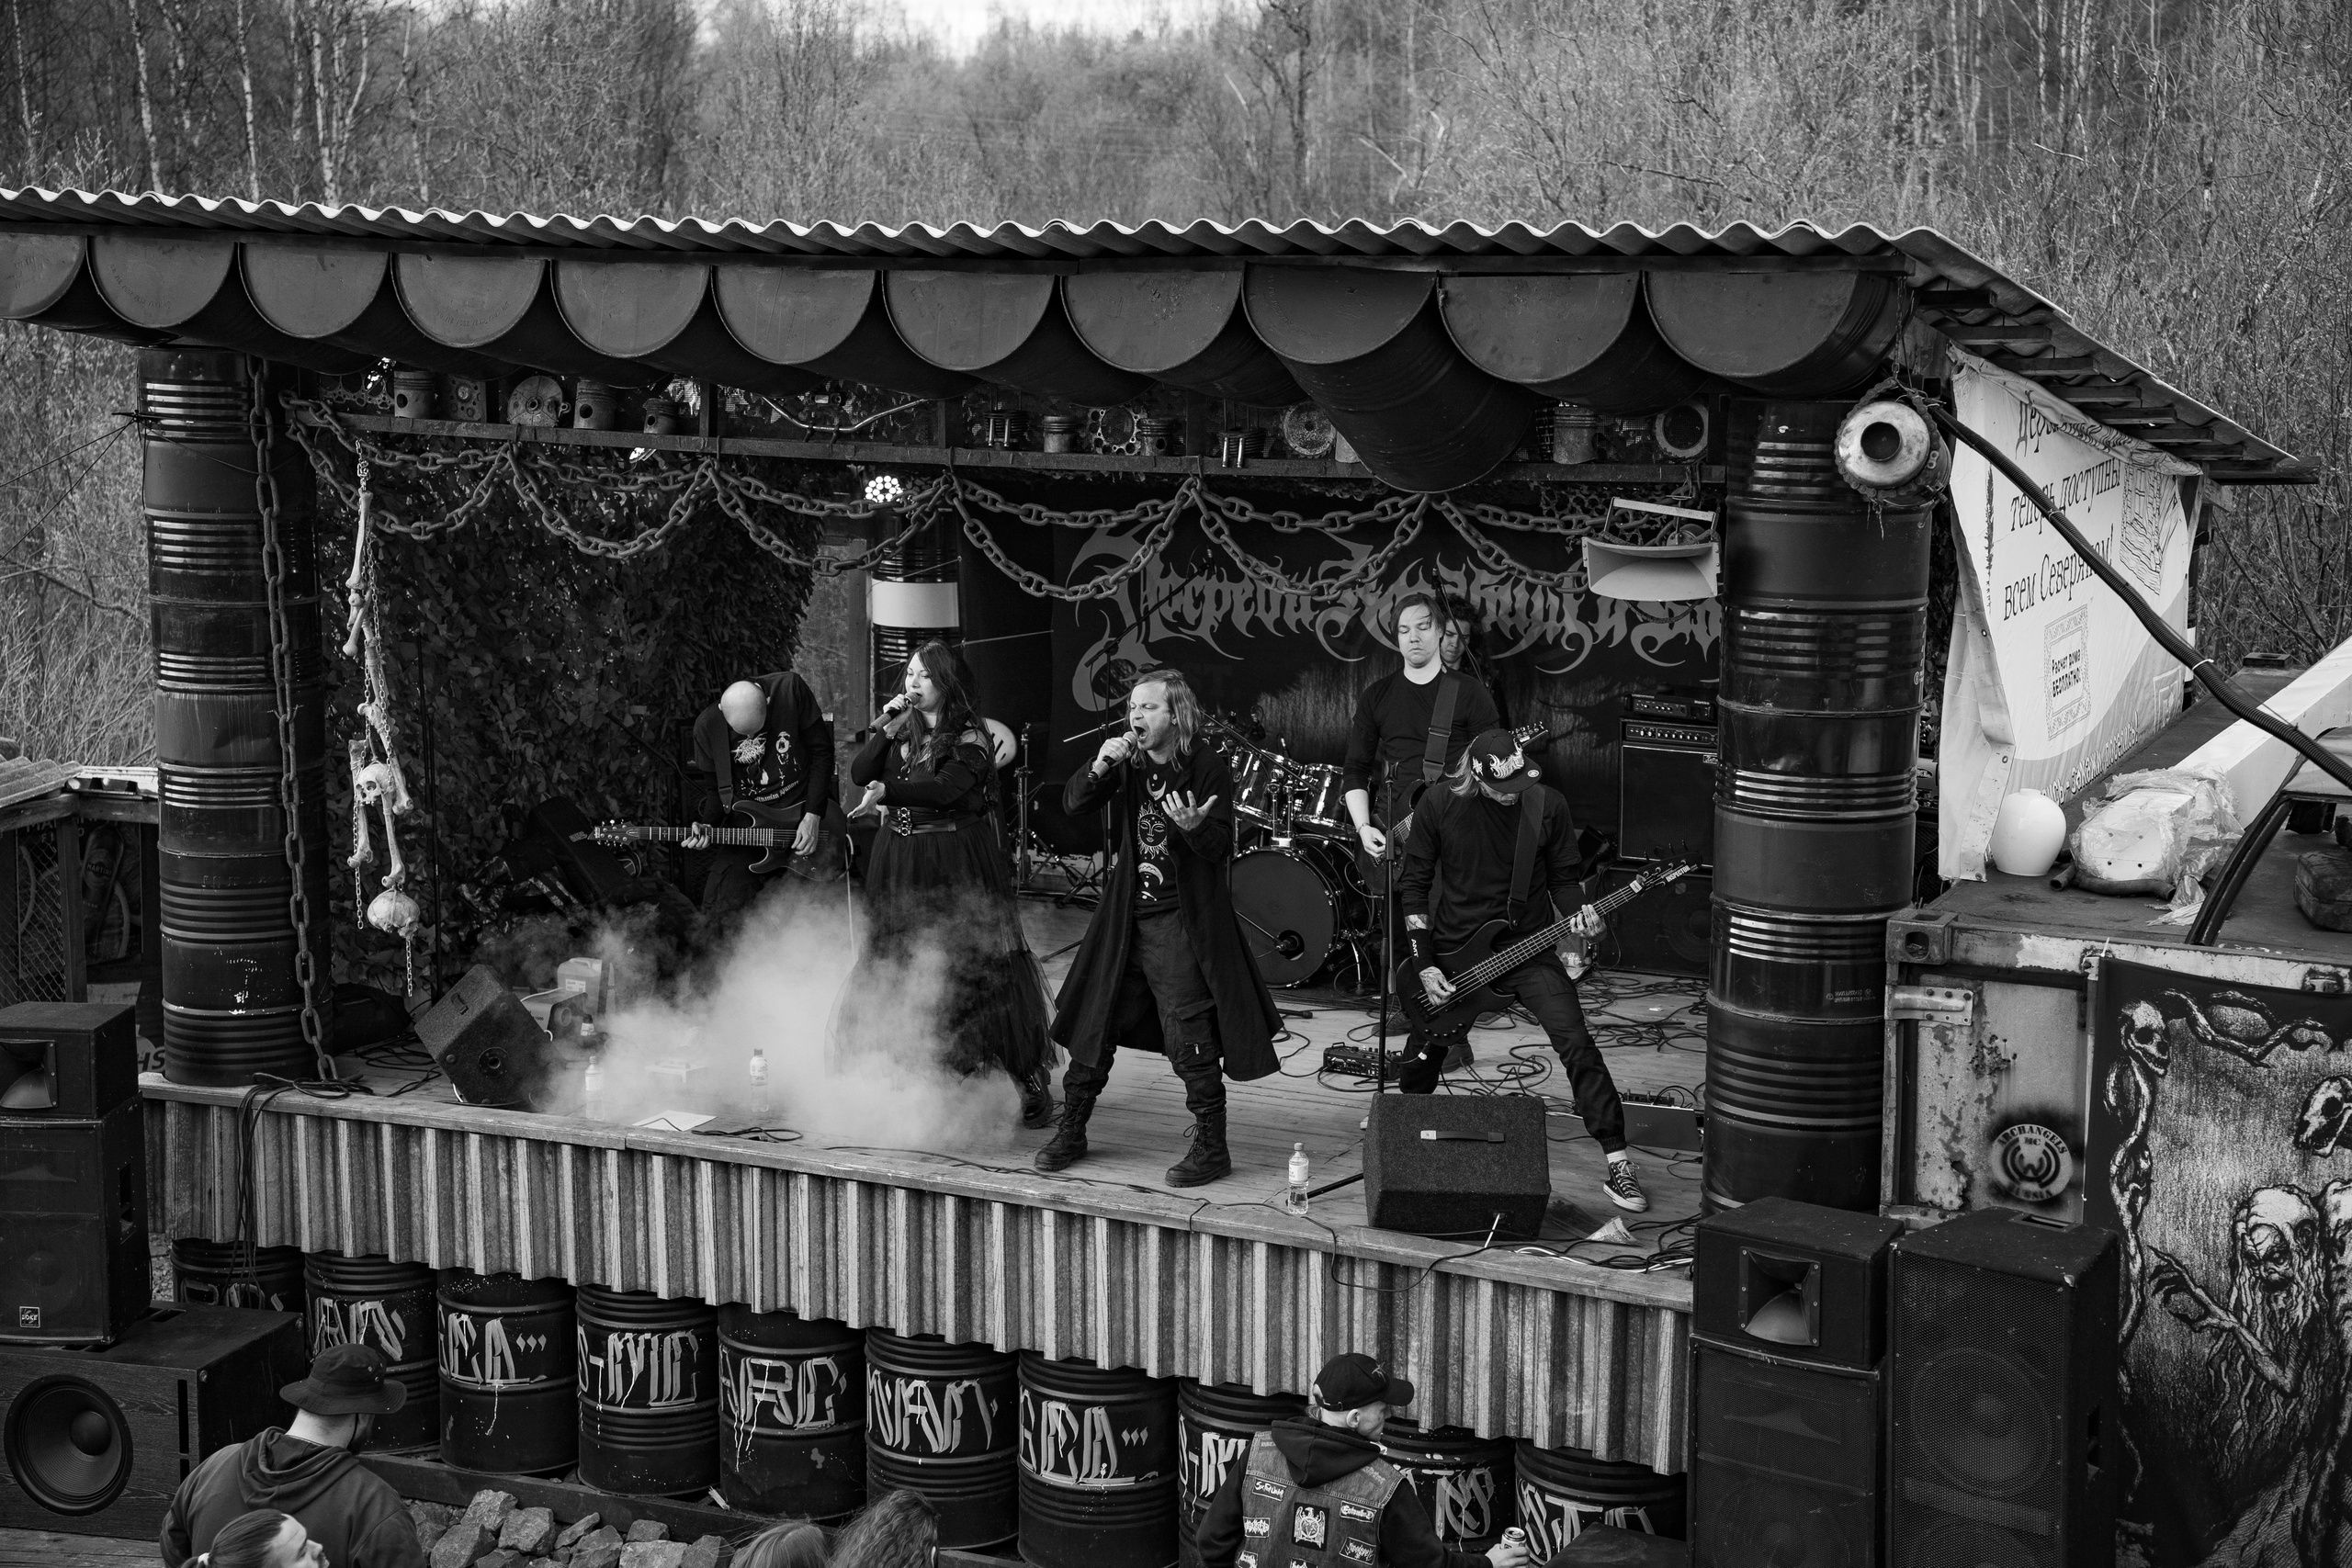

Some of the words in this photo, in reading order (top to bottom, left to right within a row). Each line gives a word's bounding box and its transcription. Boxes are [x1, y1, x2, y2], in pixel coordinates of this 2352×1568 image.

[2059, 457, 2120, 516] доступны
[2004, 573, 2036, 621] всем
[1665, 864, 1691, 883] INSPECTOR
[1996, 1125, 2068, 1155] ARCHANGELS
